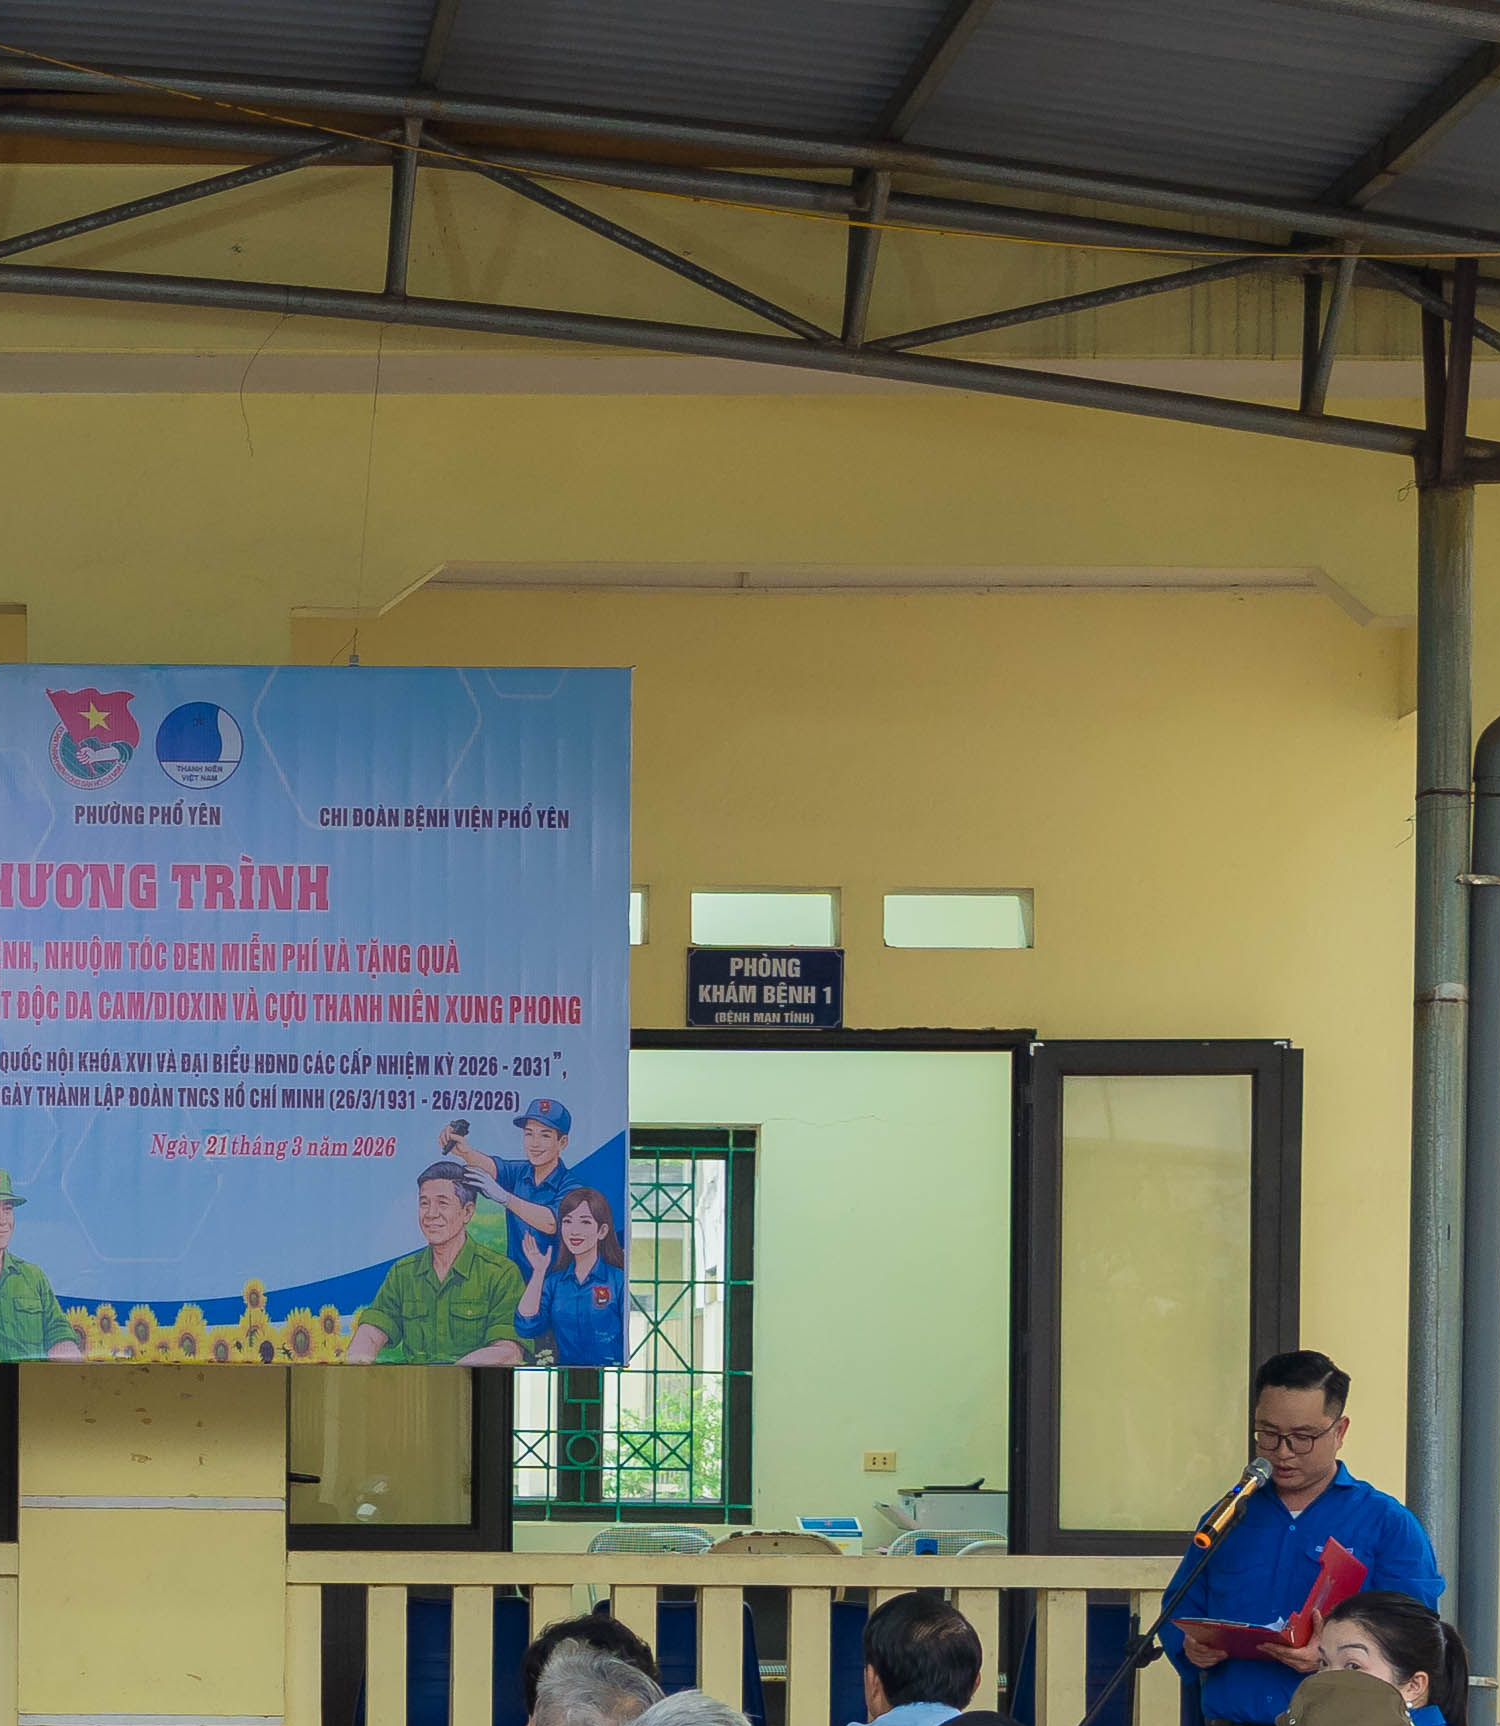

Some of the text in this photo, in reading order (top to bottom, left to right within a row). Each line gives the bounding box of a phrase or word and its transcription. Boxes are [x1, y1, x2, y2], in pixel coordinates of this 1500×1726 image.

[177, 764, 223, 773] THANH NIÊN
[181, 773, 218, 782] VIỆT NAM
[74, 798, 221, 826] PHƯỜNG PHỔ YÊN
[319, 801, 570, 834] CHI ĐOÀN BỆNH VIỆN PHỔ YÊN
[171, 854, 330, 911] TRÌNH
[45, 936, 122, 977] NHUỘM
[128, 939, 167, 972] TÓC
[173, 942, 215, 973] ĐEN
[221, 933, 274, 973] MIỄN
[282, 937, 318, 974] PHÍ
[322, 940, 350, 973] VÀ
[355, 939, 411, 980] TẶNG
[416, 938, 460, 976] QUÀ
[729, 953, 801, 978] PHÒNG
[16, 986, 59, 1027] ĐỘC
[65, 991, 93, 1020] DA
[98, 990, 227, 1023] CAM/DIOXIN
[232, 988, 260, 1023] VÀ
[265, 990, 306, 1030] CỰU
[312, 993, 383, 1024] THANH
[388, 987, 438, 1024] NIÊN
[445, 994, 503, 1025] XUNG
[509, 995, 582, 1026] PHONG
[698, 980, 832, 1008] KHÁM BỆNH 1
[714, 1010, 815, 1025] (BỆNH MẠN TÍNH)
[0, 1046, 43, 1075] QUỐC
[47, 1049, 74, 1076] HỘI
[78, 1048, 123, 1074] KHÓA
[126, 1052, 152, 1074] XVI
[157, 1049, 178, 1075] VÀ
[181, 1054, 209, 1079] ĐẠI
[213, 1044, 250, 1075] BIỂU
[254, 1053, 299, 1075] HĐND
[303, 1051, 335, 1076] CÁC
[339, 1047, 373, 1076] CẤP
[376, 1050, 430, 1080] NHIỆM
[434, 1050, 455, 1077] KỲ
[458, 1055, 498, 1077] 2026
[36, 1083, 90, 1107] THÀNH
[94, 1084, 125, 1110] LẬP
[129, 1083, 173, 1109] ĐOÀN
[177, 1088, 219, 1108] TNCS
[223, 1081, 246, 1109] HỒ
[250, 1085, 277, 1109] CHÍ
[281, 1089, 325, 1109] MINH
[329, 1090, 416, 1112] (26/3/1931
[431, 1090, 520, 1113] 26/3/2026)
[150, 1133, 397, 1162] Ngày 21 tháng 3 năm 2026
